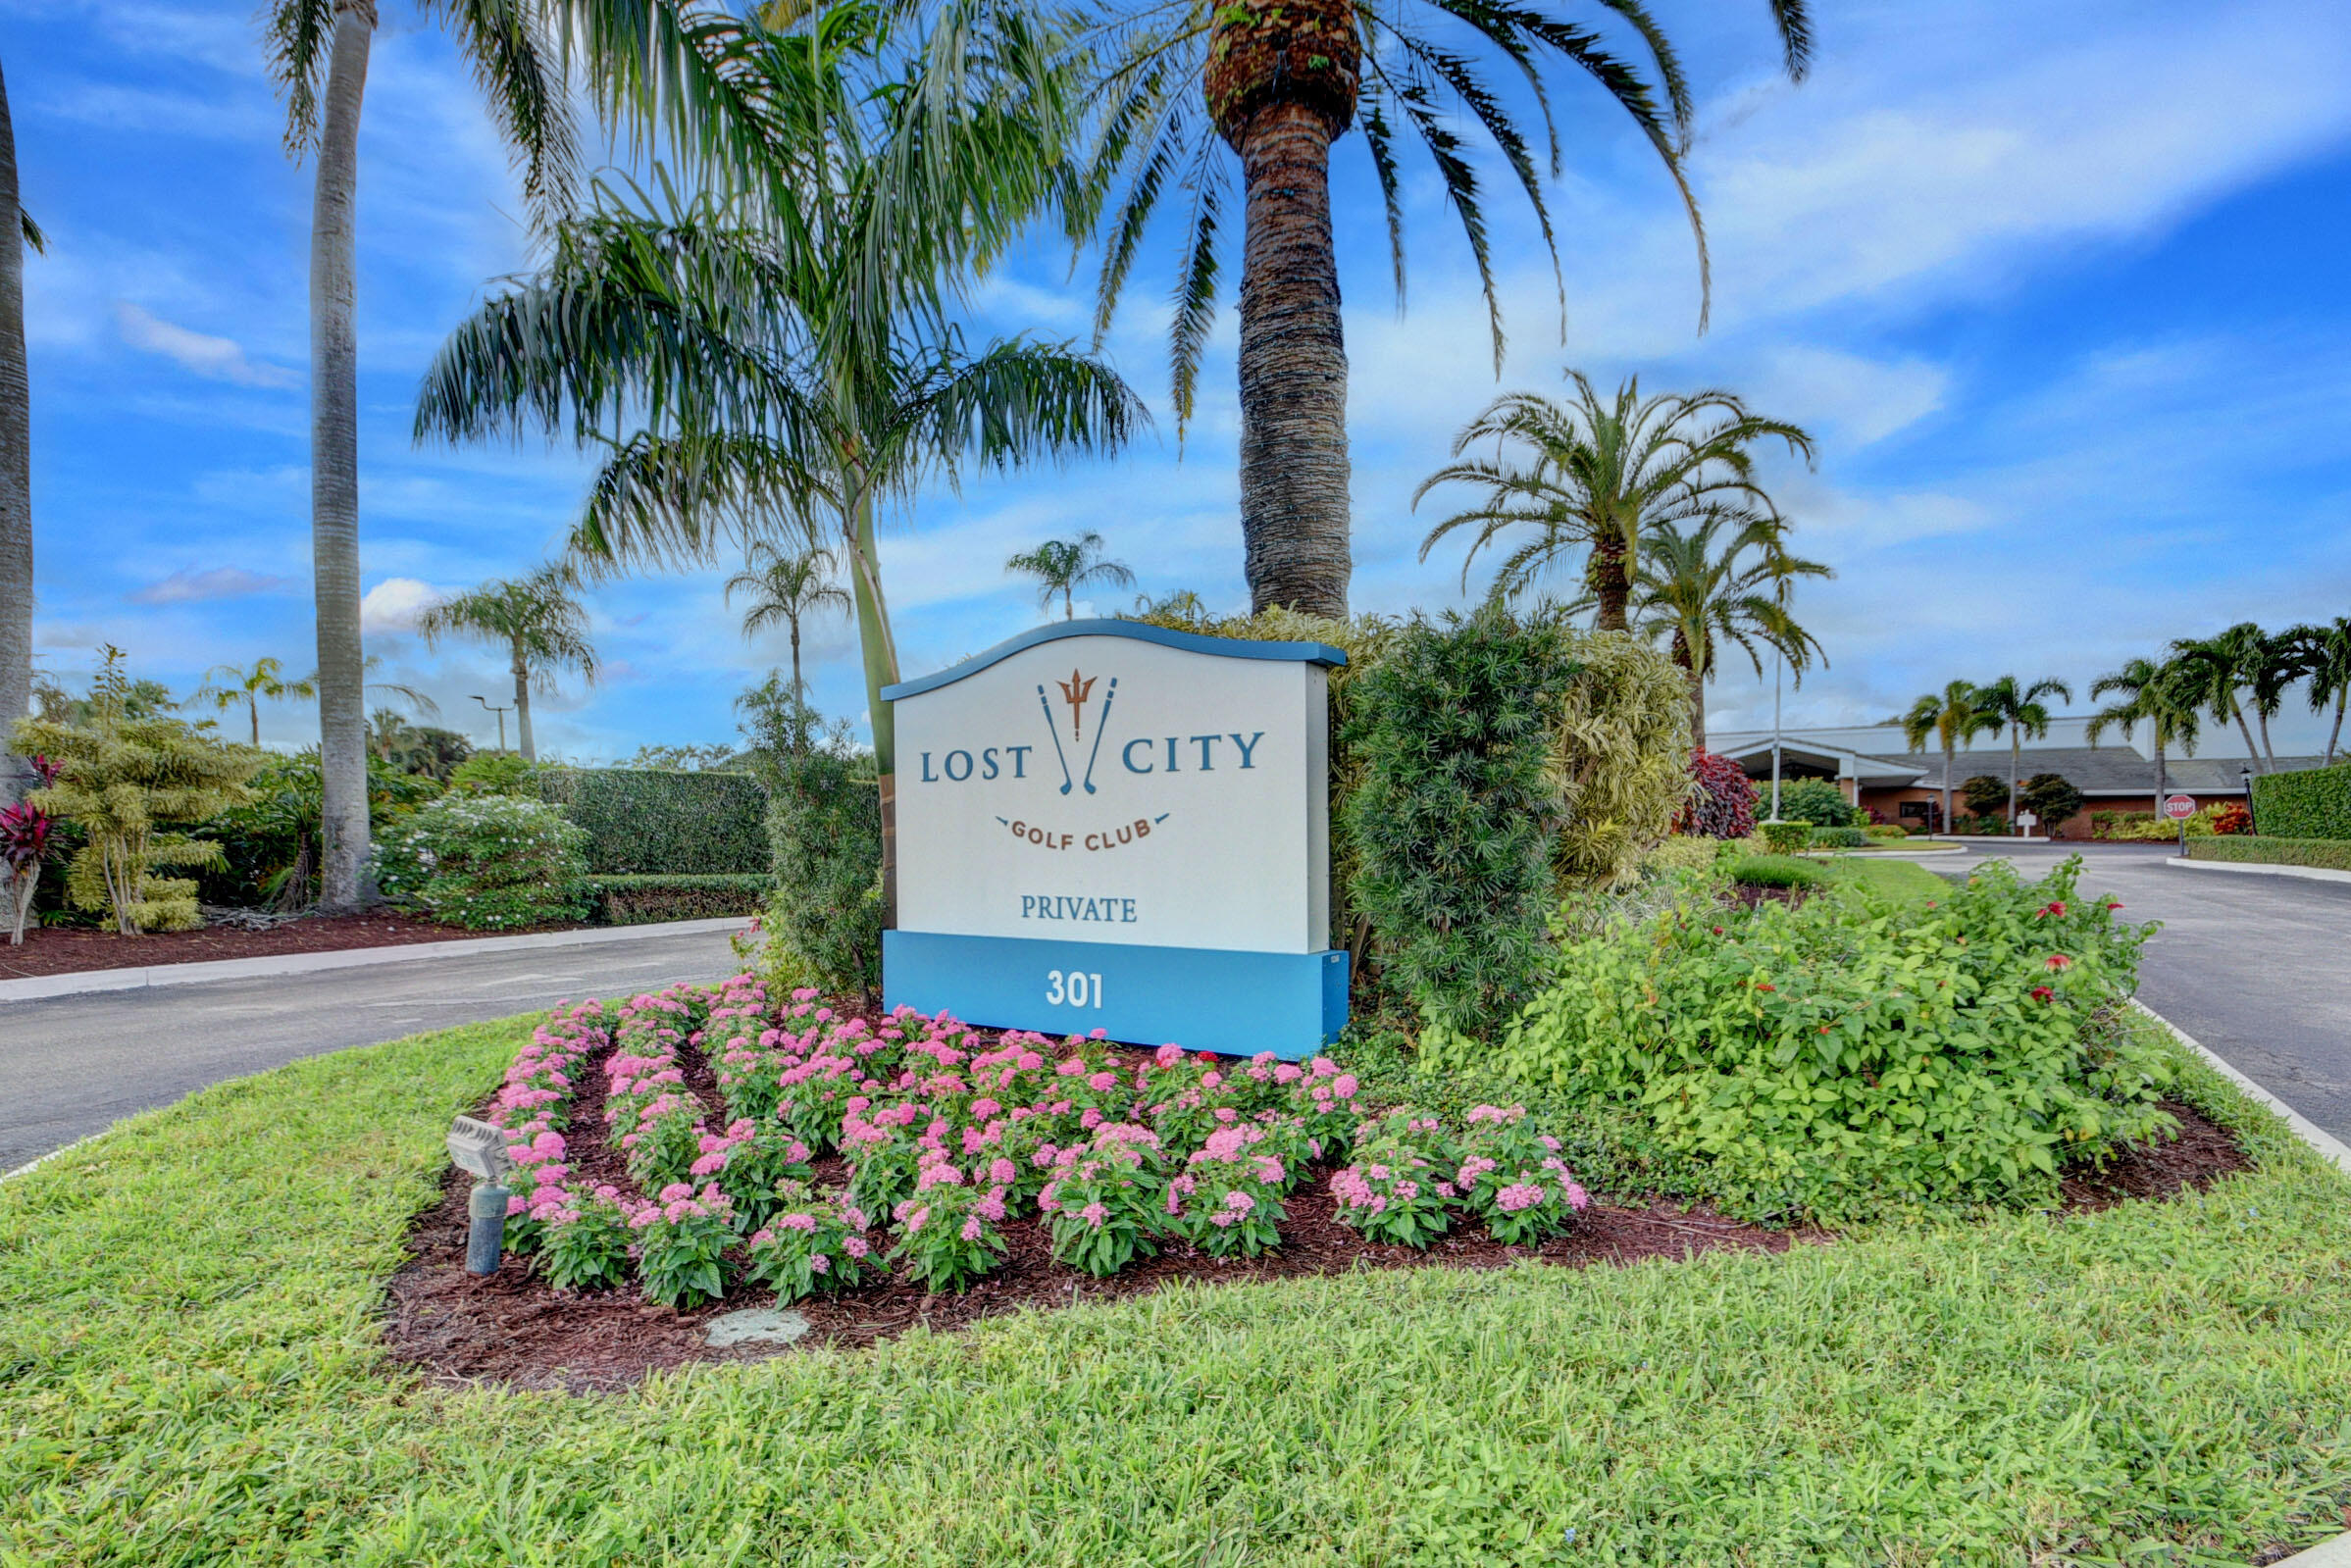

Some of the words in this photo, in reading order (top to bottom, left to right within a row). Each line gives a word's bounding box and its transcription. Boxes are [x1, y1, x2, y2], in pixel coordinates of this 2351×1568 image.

[921, 746, 1032, 783] LOST
[1123, 732, 1265, 773] CITY
[2167, 801, 2192, 812] STOP
[1011, 821, 1074, 850] GOLF
[1085, 819, 1150, 851] CLUB
[1022, 895, 1138, 923] PRIVATE
[1046, 970, 1102, 1009] 301
